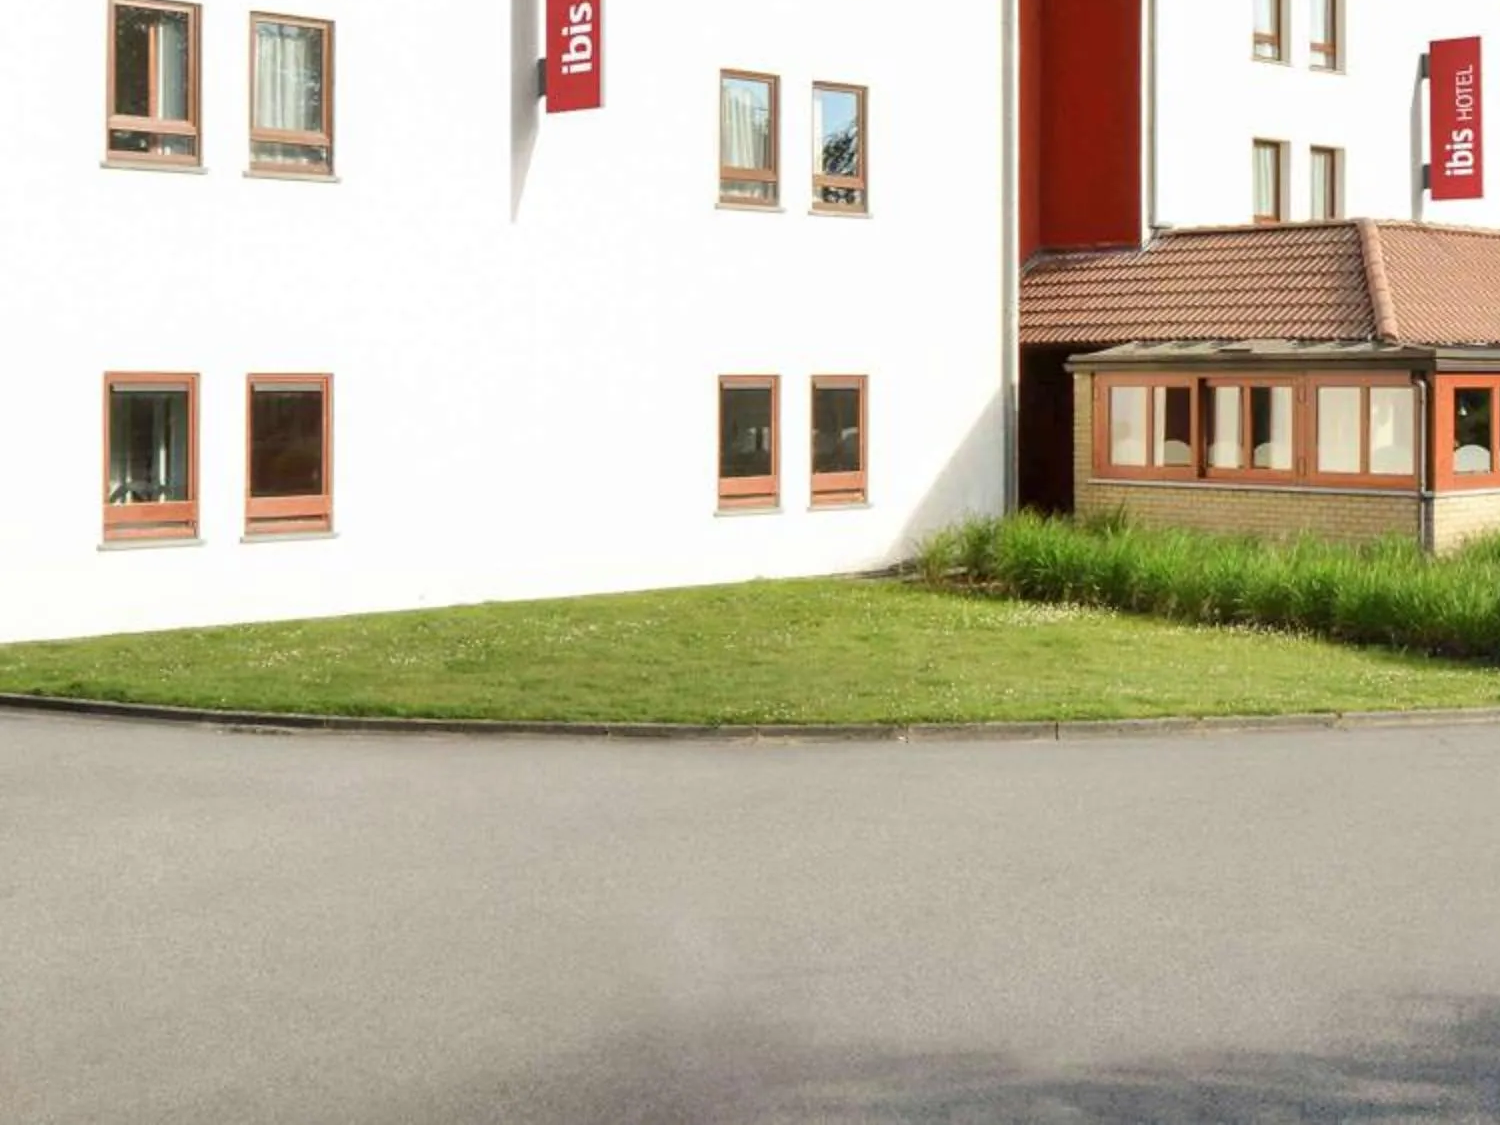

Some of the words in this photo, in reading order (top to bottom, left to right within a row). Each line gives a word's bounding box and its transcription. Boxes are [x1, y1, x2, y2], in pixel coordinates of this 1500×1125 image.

[561, 1, 593, 75] ibis
[1455, 64, 1474, 121] HOTEL
[1445, 128, 1474, 177] ibis
